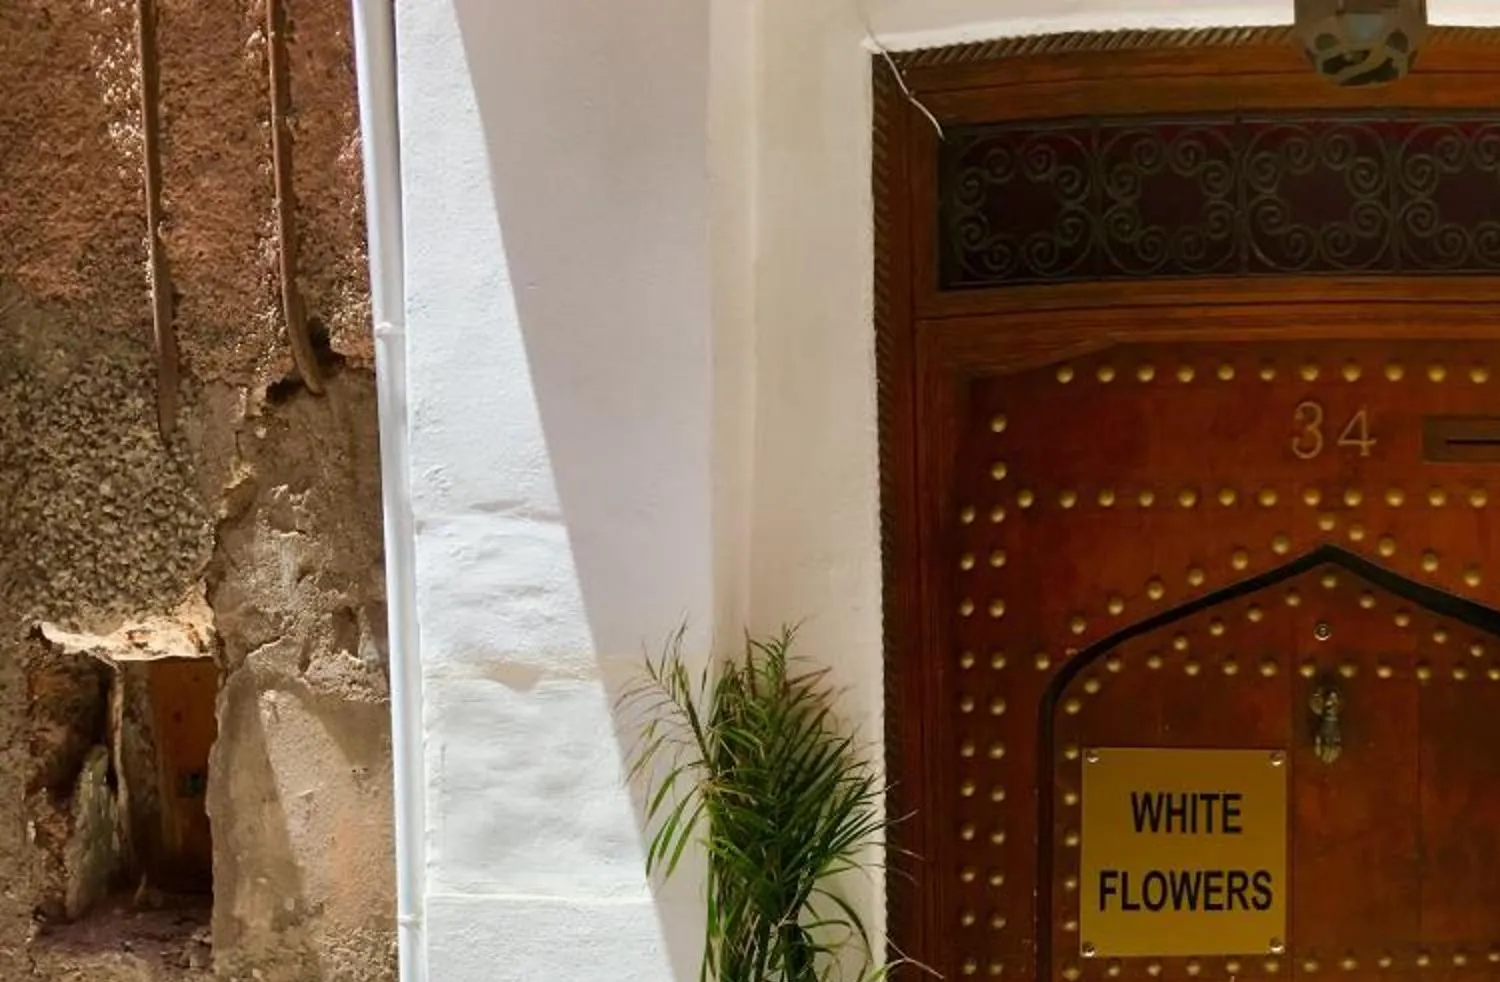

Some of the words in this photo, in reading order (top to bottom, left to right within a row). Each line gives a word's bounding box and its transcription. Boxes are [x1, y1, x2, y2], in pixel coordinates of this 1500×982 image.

[1292, 401, 1377, 459] 34
[1130, 792, 1243, 834] WHITE
[1099, 870, 1273, 912] FLOWERS
